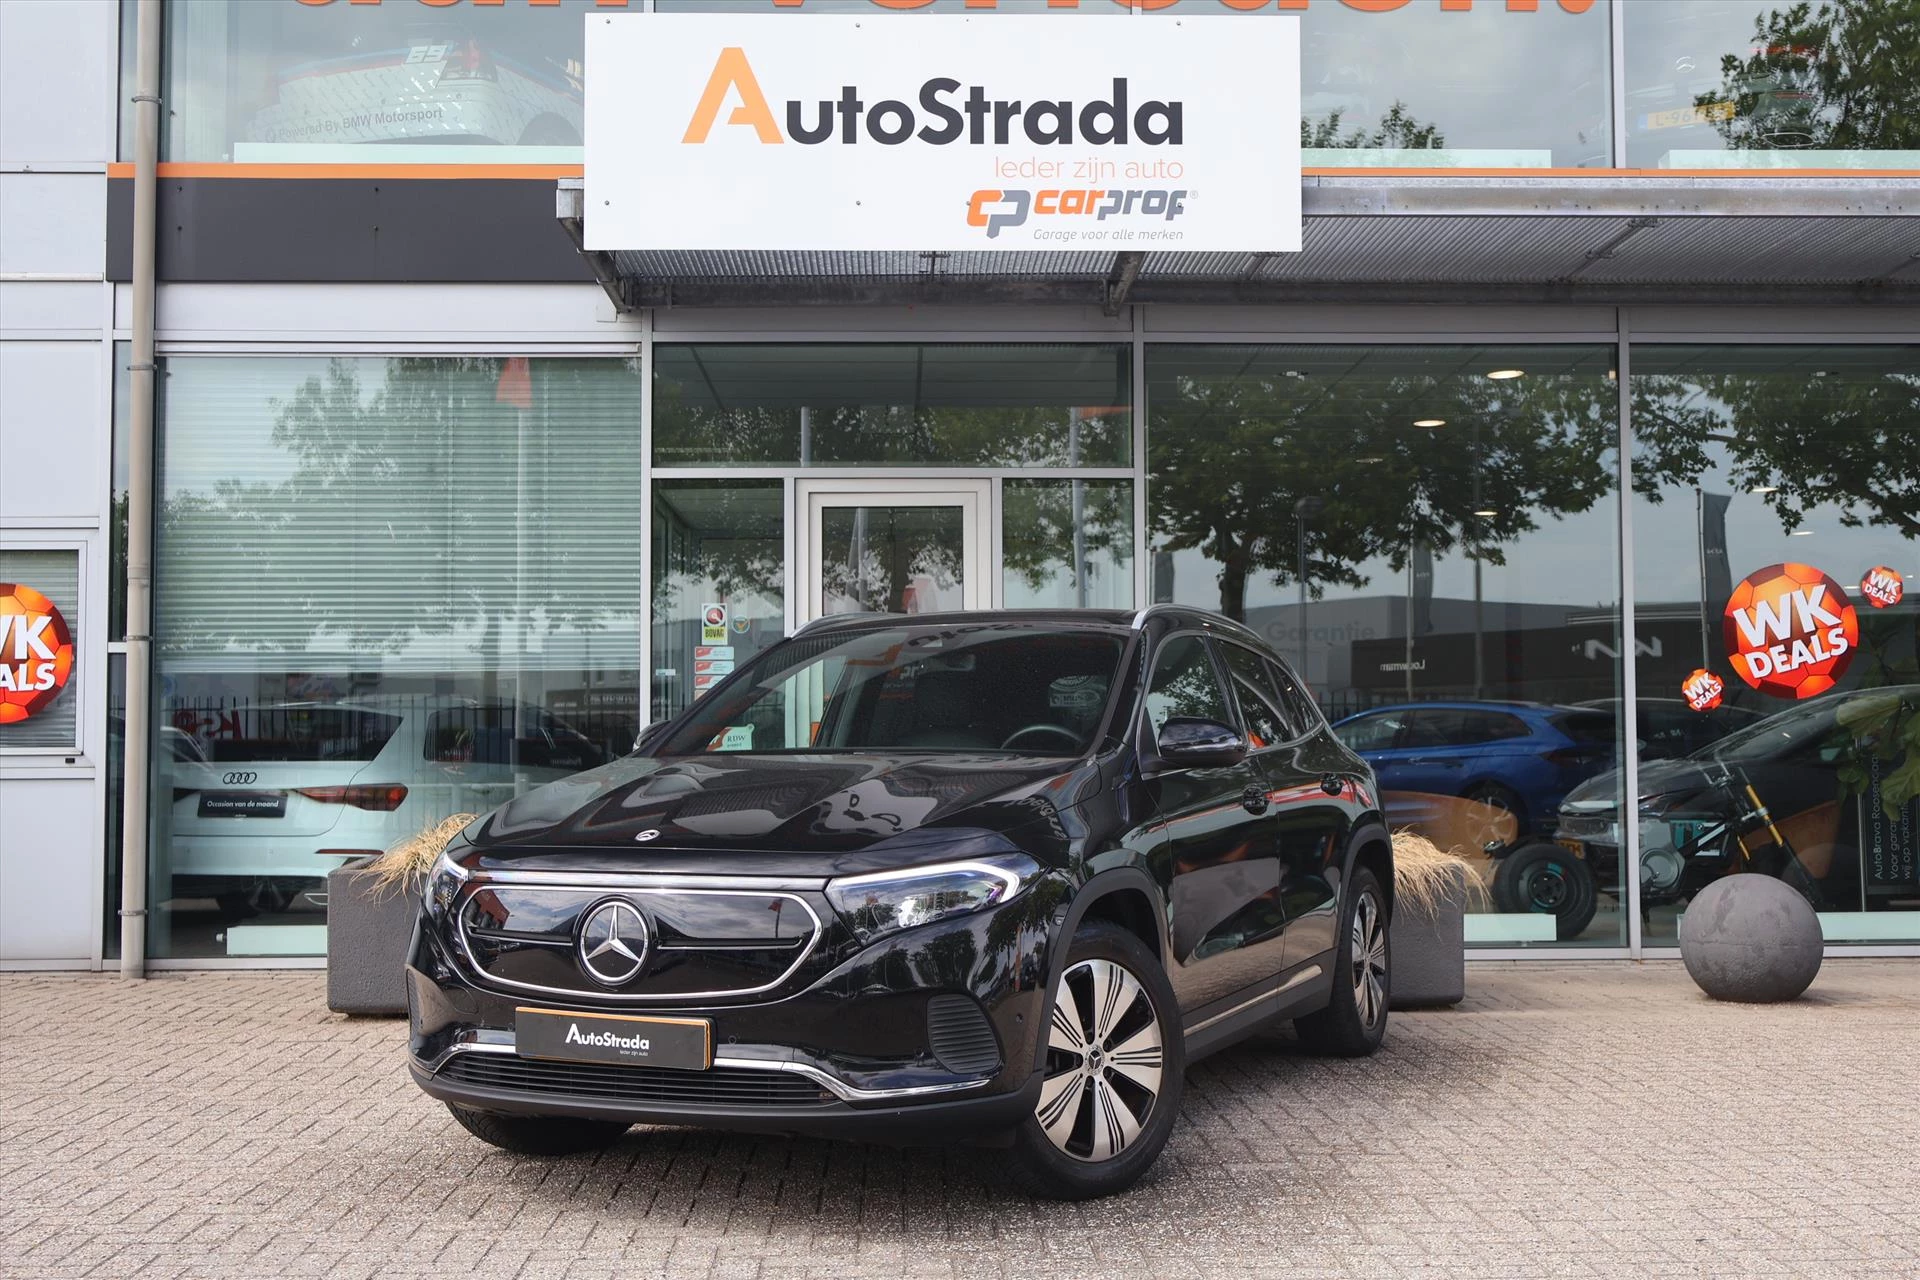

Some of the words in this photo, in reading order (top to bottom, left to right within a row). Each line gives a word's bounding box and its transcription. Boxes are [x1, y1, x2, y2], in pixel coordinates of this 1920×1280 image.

[406, 45, 448, 64] 69
[681, 47, 1183, 146] AutoStrada
[278, 123, 323, 140] Powered
[325, 120, 339, 134] By
[343, 115, 372, 129] BMW
[375, 109, 443, 125] Motorsport
[995, 156, 1064, 179] Ieder
[1072, 156, 1115, 184] zijn
[1125, 158, 1184, 179] auto
[1033, 190, 1188, 221] carprof
[1033, 229, 1077, 242] Garage
[1081, 231, 1109, 240] voor
[1112, 229, 1136, 240] alle
[1138, 229, 1184, 240] merken
[1864, 585, 1897, 605] DEALS
[1869, 571, 1901, 596] WK
[1732, 583, 1842, 648] WK
[0, 614, 57, 660] K
[705, 628, 725, 639] BOVAG
[1266, 621, 1377, 641] Garantie
[1744, 627, 1849, 679] DEALS
[0, 662, 56, 692] ALS
[1683, 672, 1717, 700] WK
[1693, 682, 1722, 709] DEALS
[207, 800, 234, 808] Occasion
[247, 800, 256, 808] de
[256, 800, 279, 808] maand
[1873, 822, 1883, 880] AutoBrava
[1902, 847, 1912, 863] op
[1889, 853, 1899, 880] Voor
[1901, 864, 1912, 880] wij
[565, 1023, 650, 1050] AutoStrada
